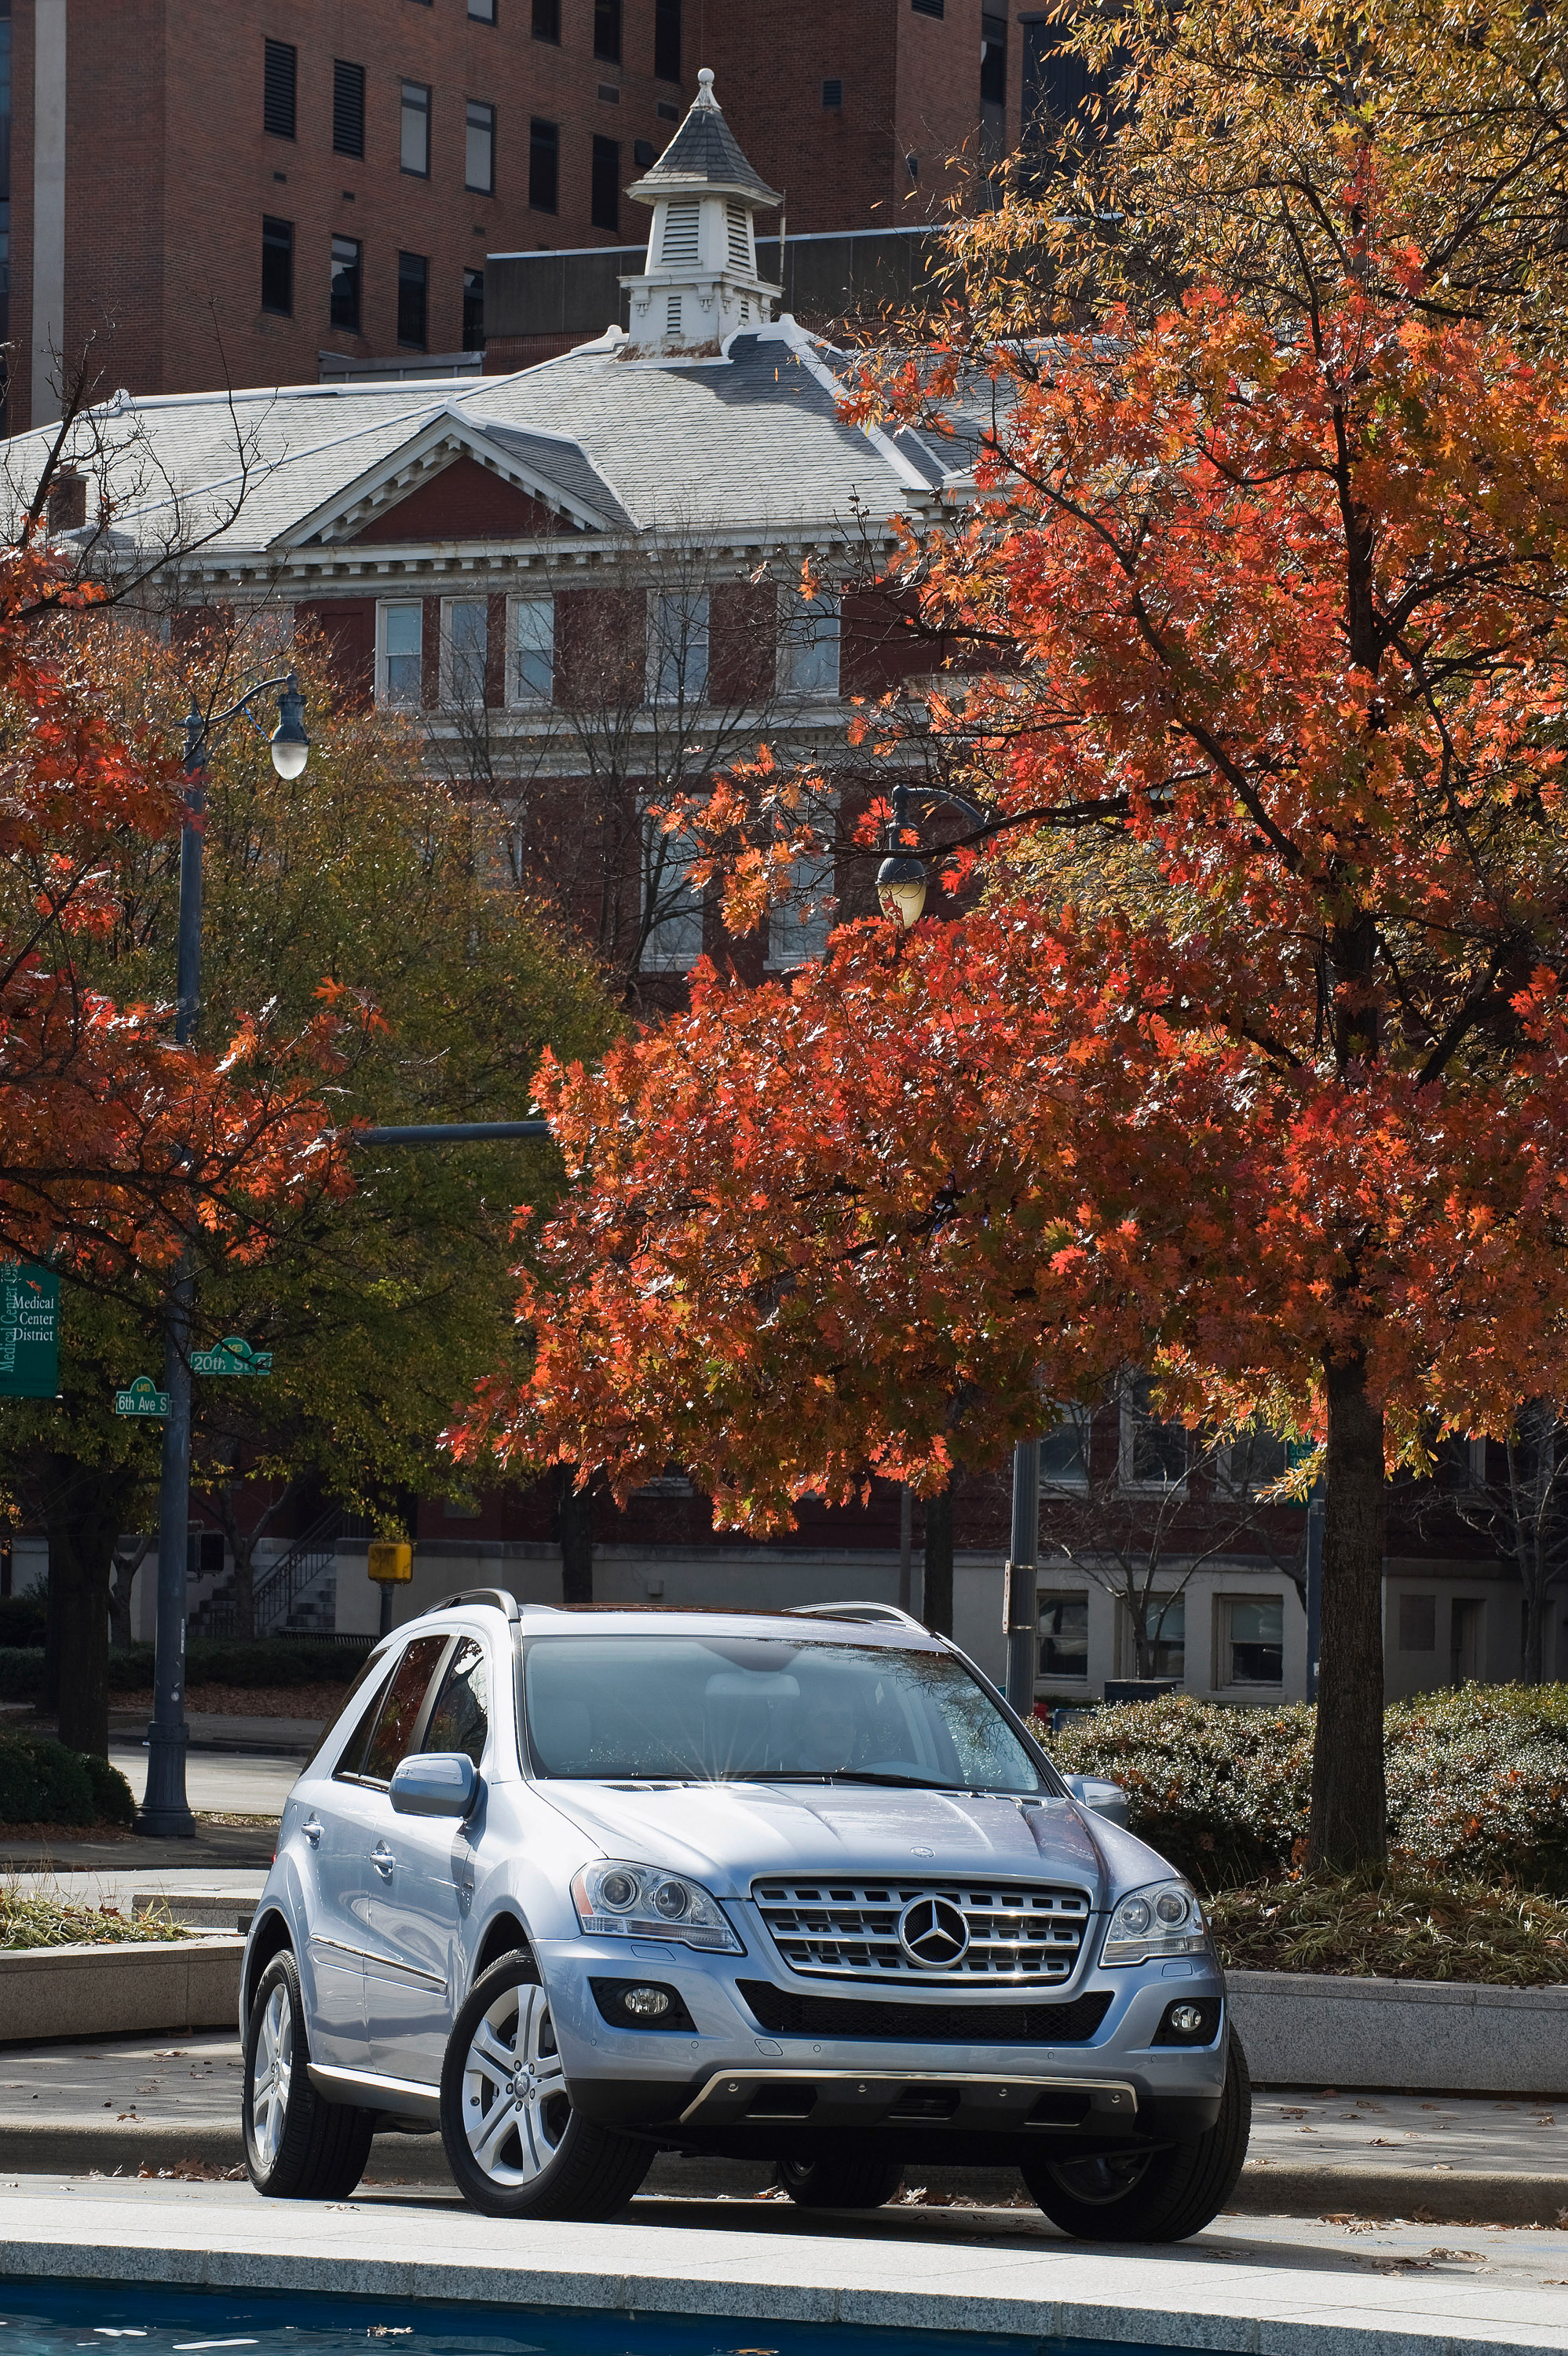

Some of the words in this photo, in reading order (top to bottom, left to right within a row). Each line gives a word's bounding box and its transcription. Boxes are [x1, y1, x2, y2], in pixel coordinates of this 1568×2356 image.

[0, 1286, 17, 1324] Center
[13, 1295, 54, 1309] Medical
[20, 1312, 54, 1325] Center
[13, 1327, 53, 1341] District
[0, 1327, 16, 1372] Medical
[194, 1355, 226, 1370] 20th
[232, 1356, 249, 1371] St
[119, 1396, 134, 1410] 6th
[138, 1396, 155, 1411] Ave
[159, 1396, 167, 1412] S
